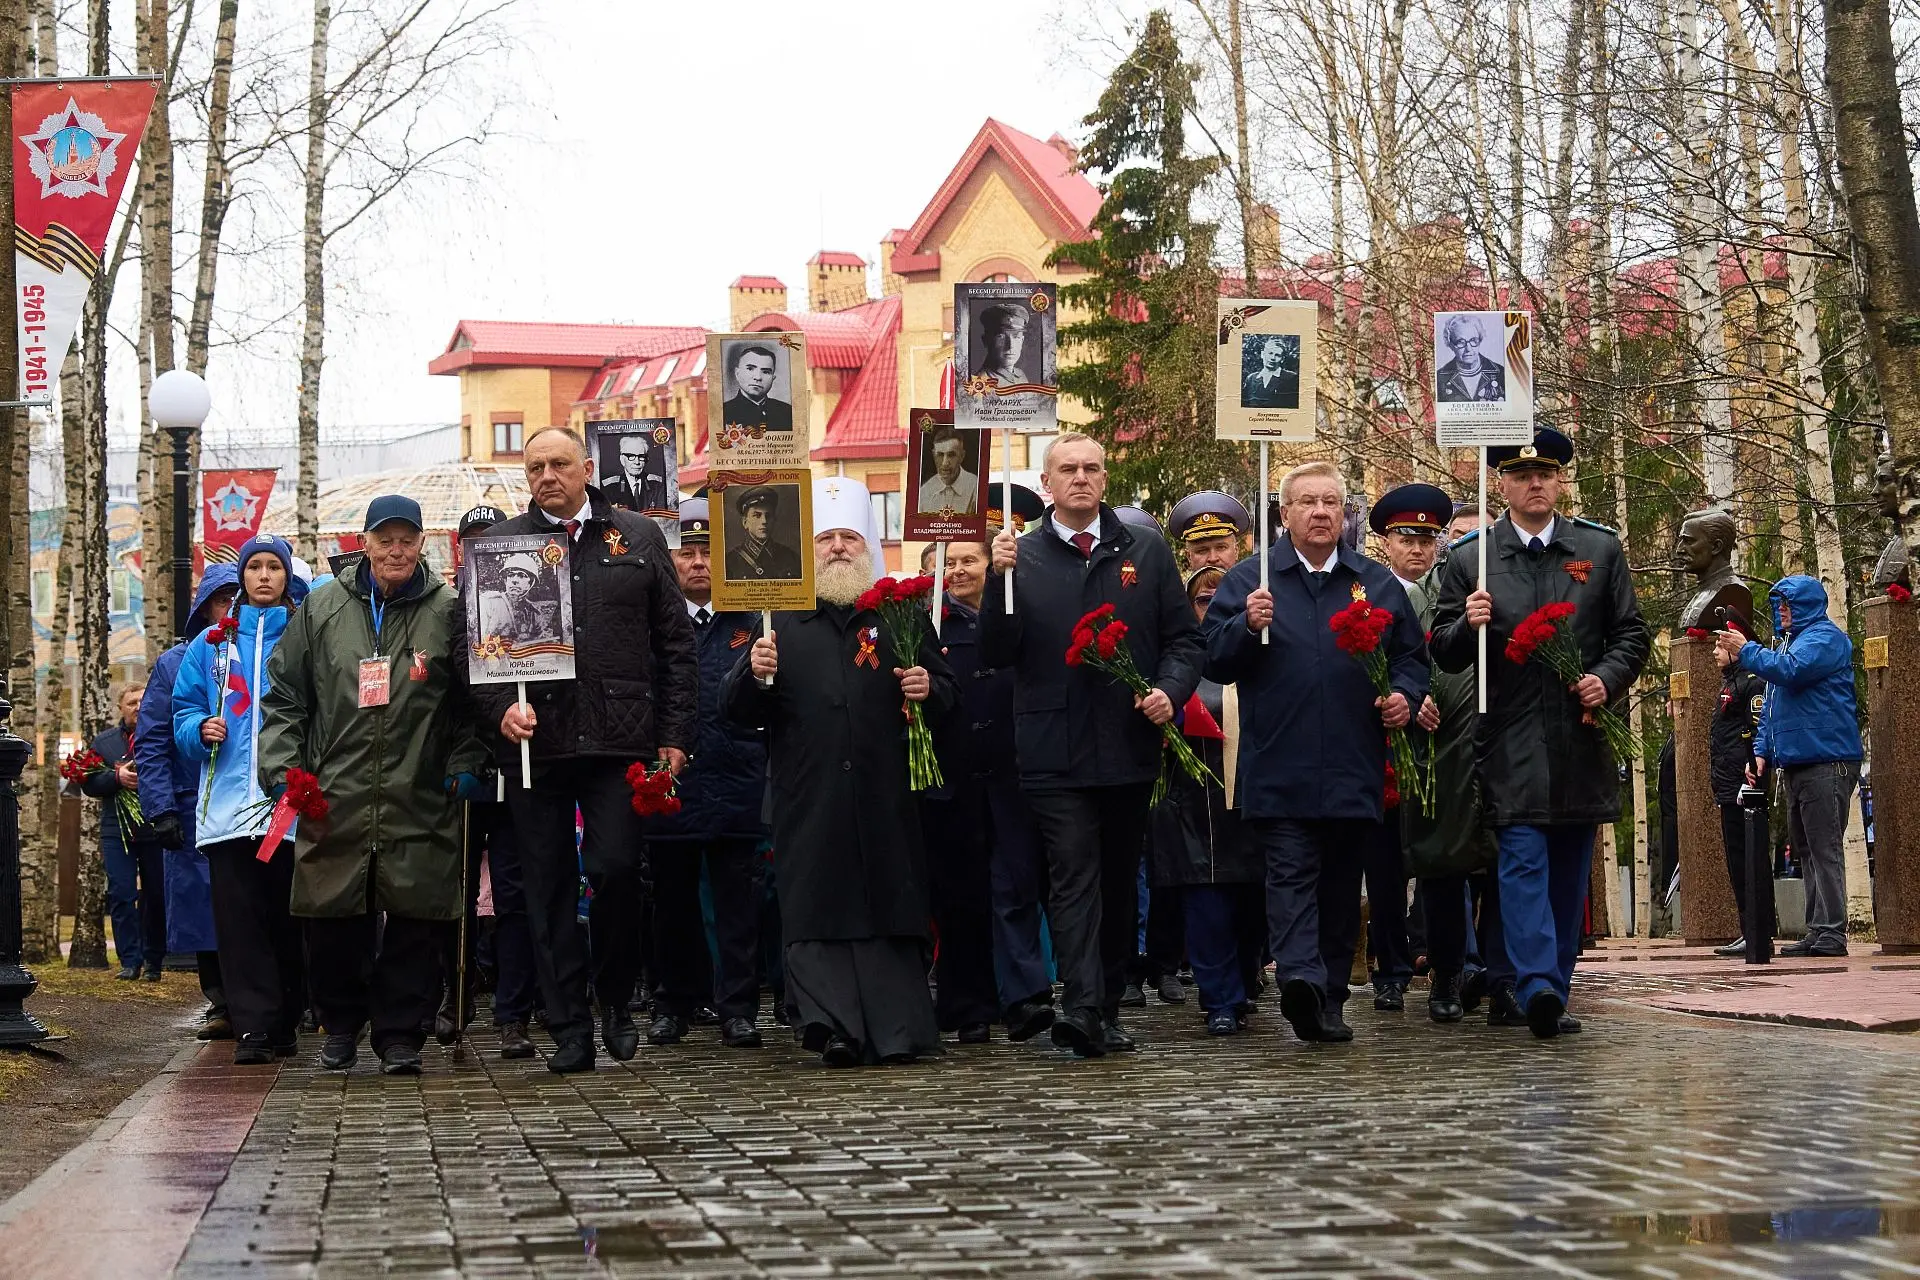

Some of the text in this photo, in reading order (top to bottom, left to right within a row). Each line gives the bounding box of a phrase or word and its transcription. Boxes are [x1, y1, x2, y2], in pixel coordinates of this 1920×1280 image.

[23, 284, 48, 394] 1941-1945
[994, 408, 1037, 416] Григорьевич
[765, 434, 793, 442] ФОКИН
[716, 456, 777, 465] БЕССМЕРТНЫЙ
[467, 507, 496, 523] UGRA
[474, 539, 546, 550] БЕССМЕРТНЫЙ ПОЛК
[509, 660, 535, 669] ЮРЬЕВ
[486, 668, 559, 678] Михаил Максимович
